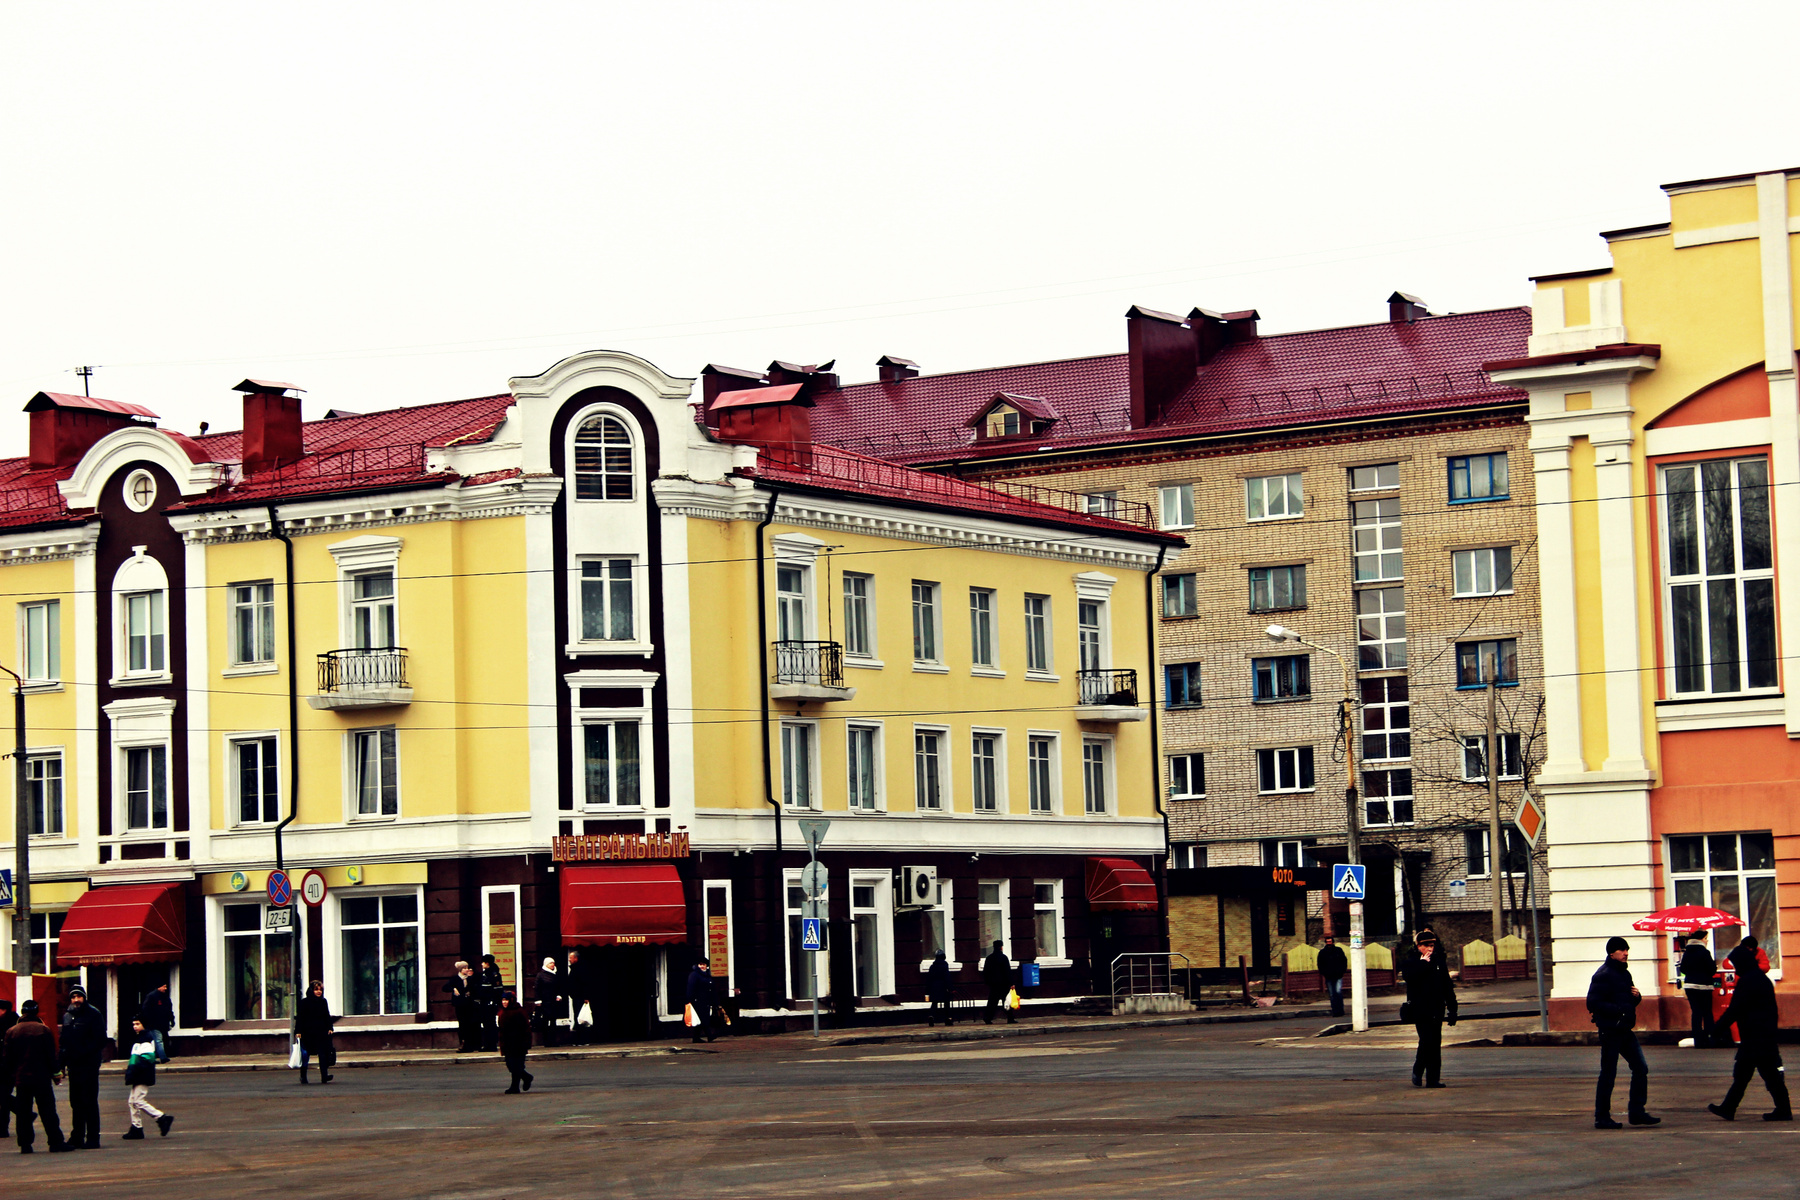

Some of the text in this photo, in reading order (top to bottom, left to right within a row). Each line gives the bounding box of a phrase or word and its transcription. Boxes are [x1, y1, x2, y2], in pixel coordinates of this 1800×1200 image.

[551, 825, 690, 862] ЦЕНТРАЛЬНЫЙ
[1272, 866, 1293, 883] ФОТО
[307, 883, 320, 898] 40
[269, 911, 288, 926] 22-6
[616, 935, 647, 944] Альтаир
